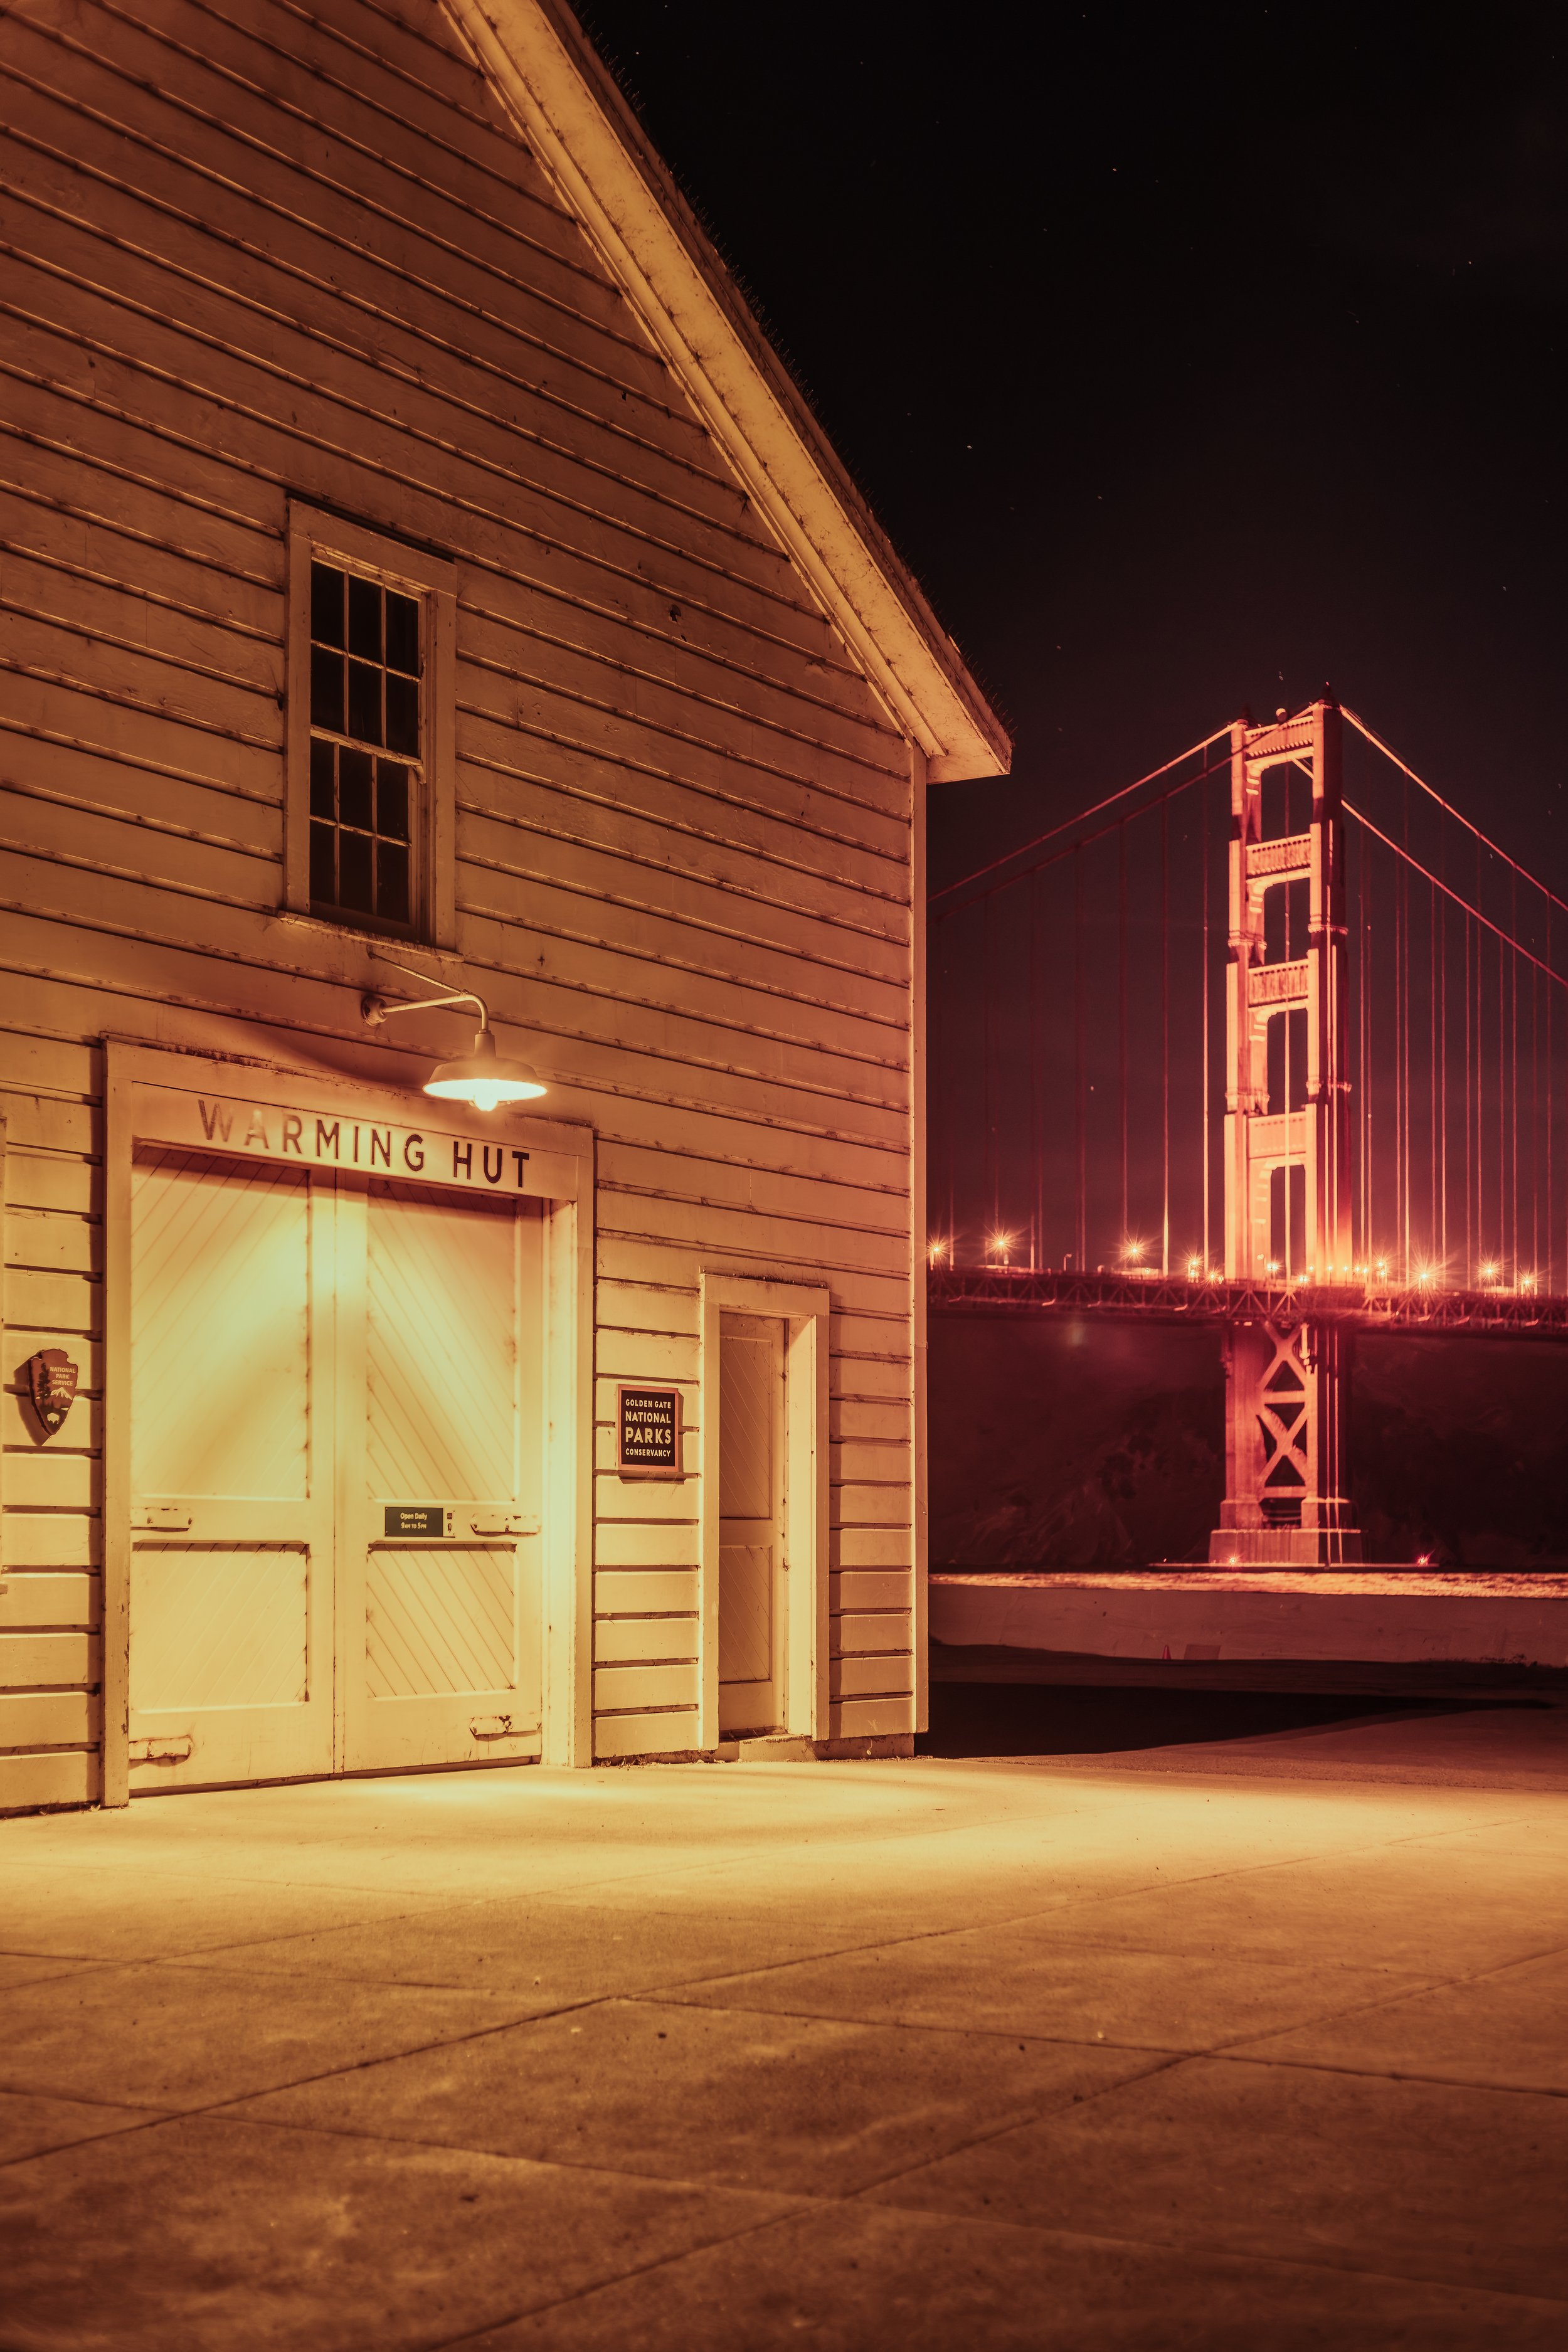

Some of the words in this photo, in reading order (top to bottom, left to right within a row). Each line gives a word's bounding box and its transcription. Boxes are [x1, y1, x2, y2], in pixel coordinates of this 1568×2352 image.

[198, 1099, 424, 1172] WARMING
[453, 1141, 530, 1188] HUT
[625, 1399, 652, 1407] GOLDEN
[654, 1401, 671, 1409] GATE
[625, 1411, 671, 1424] NATIONAL
[625, 1426, 671, 1444] PARKS
[625, 1448, 671, 1457] CONSERVANCY
[400, 1512, 414, 1520] Open
[415, 1512, 428, 1521] Daily
